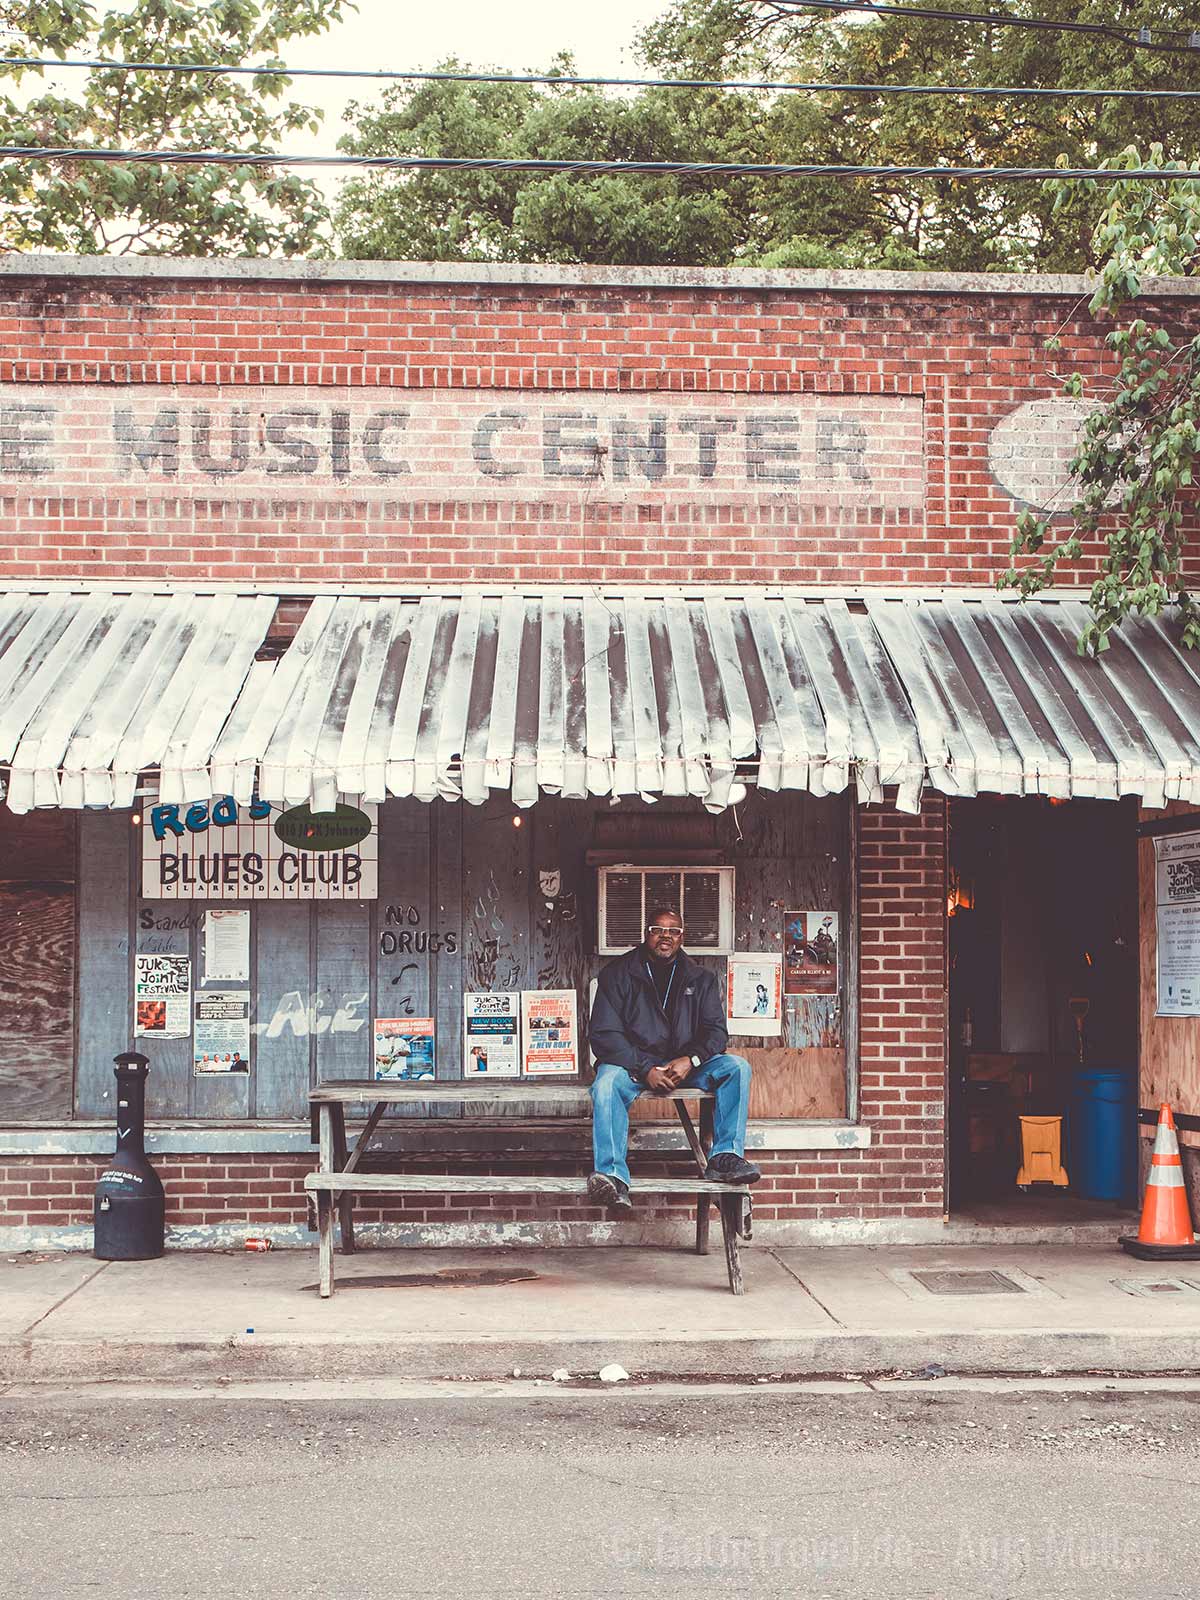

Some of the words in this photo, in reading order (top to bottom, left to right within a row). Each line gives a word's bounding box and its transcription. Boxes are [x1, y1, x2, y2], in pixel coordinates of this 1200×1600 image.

[115, 405, 412, 480] MUSIC
[472, 409, 869, 486] CENTER
[160, 852, 263, 884] BLUES
[277, 852, 362, 884] CLUB
[385, 905, 420, 926] NO
[380, 930, 458, 956] DRUGS
[536, 1041, 553, 1049] NEW
